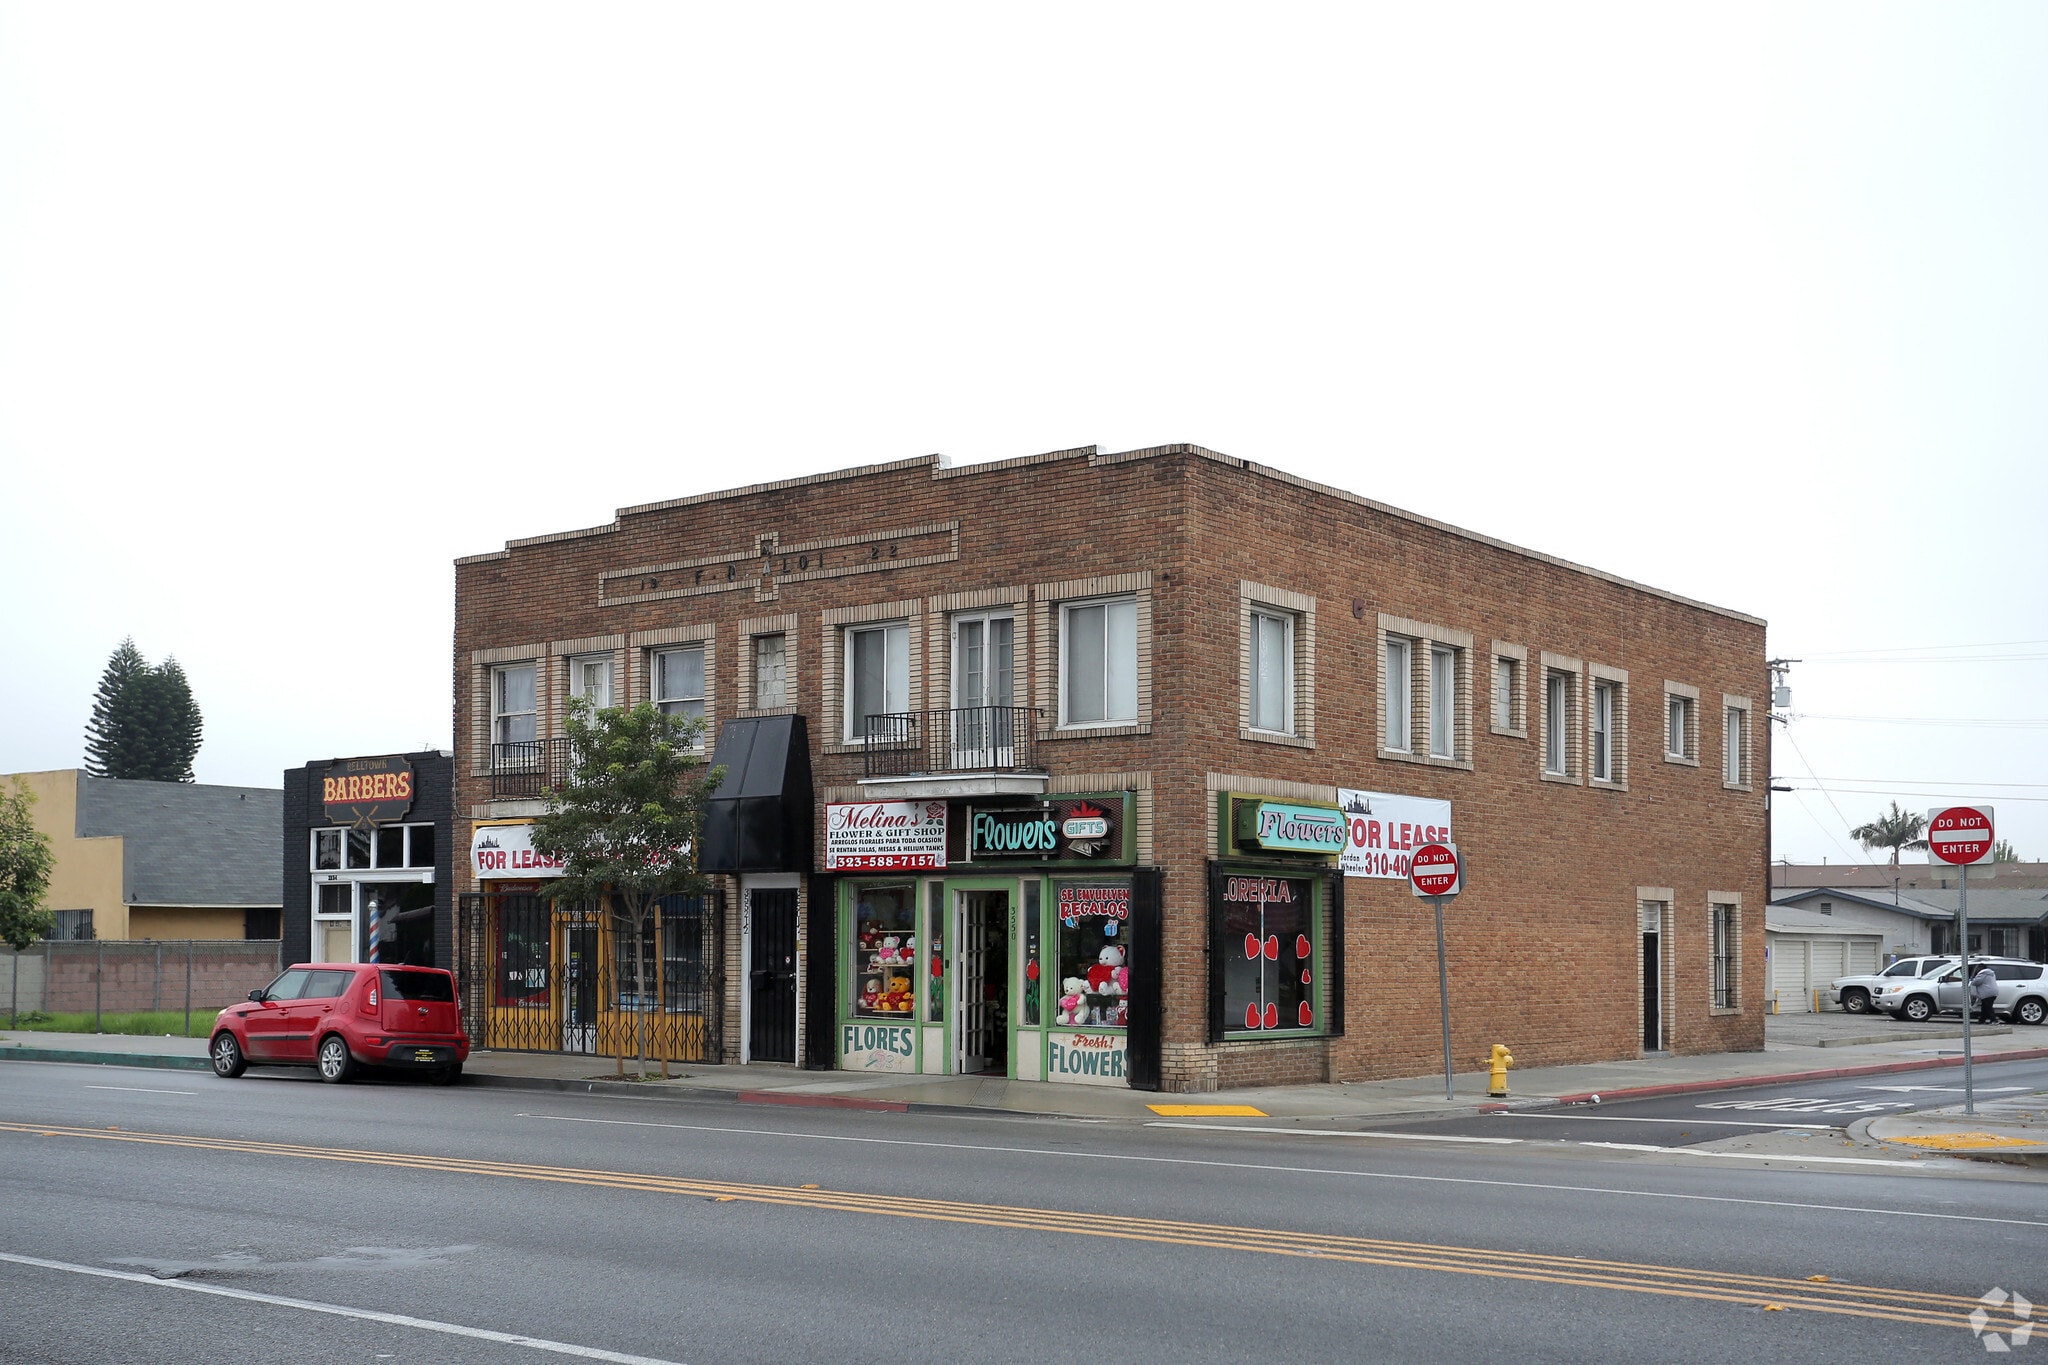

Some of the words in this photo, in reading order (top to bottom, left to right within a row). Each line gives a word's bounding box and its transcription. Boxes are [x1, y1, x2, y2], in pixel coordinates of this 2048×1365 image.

[870, 544, 898, 560] 22
[347, 759, 387, 771] BELLTOWN
[323, 771, 412, 804] BARBERS
[828, 803, 924, 830] Melina's
[1938, 818, 1953, 828] DO
[1960, 817, 1982, 827] NOT
[829, 830, 873, 839] FLOWER
[875, 829, 883, 837] &
[886, 828, 911, 837] GIFT
[914, 827, 945, 836] SHOP
[973, 813, 1056, 851] Flowers
[1065, 821, 1104, 835] GIFTS
[1259, 810, 1345, 844] Flowers
[1942, 843, 1980, 854] ENTER
[477, 850, 507, 870] FOR
[512, 848, 565, 869] LEASE
[837, 855, 935, 868] 323-588-7157
[1417, 854, 1429, 863] DO
[1433, 853, 1449, 862] NOT
[1340, 862, 1364, 872] Wheeler
[1421, 876, 1449, 886] ENTER
[1061, 887, 1075, 902] SE
[1076, 887, 1130, 902] ENVUELVEN
[1223, 877, 1291, 903] ORERIA
[1060, 901, 1129, 921] REGALOS
[843, 1025, 913, 1057] FLORES
[1072, 1033, 1115, 1049] Fresh!
